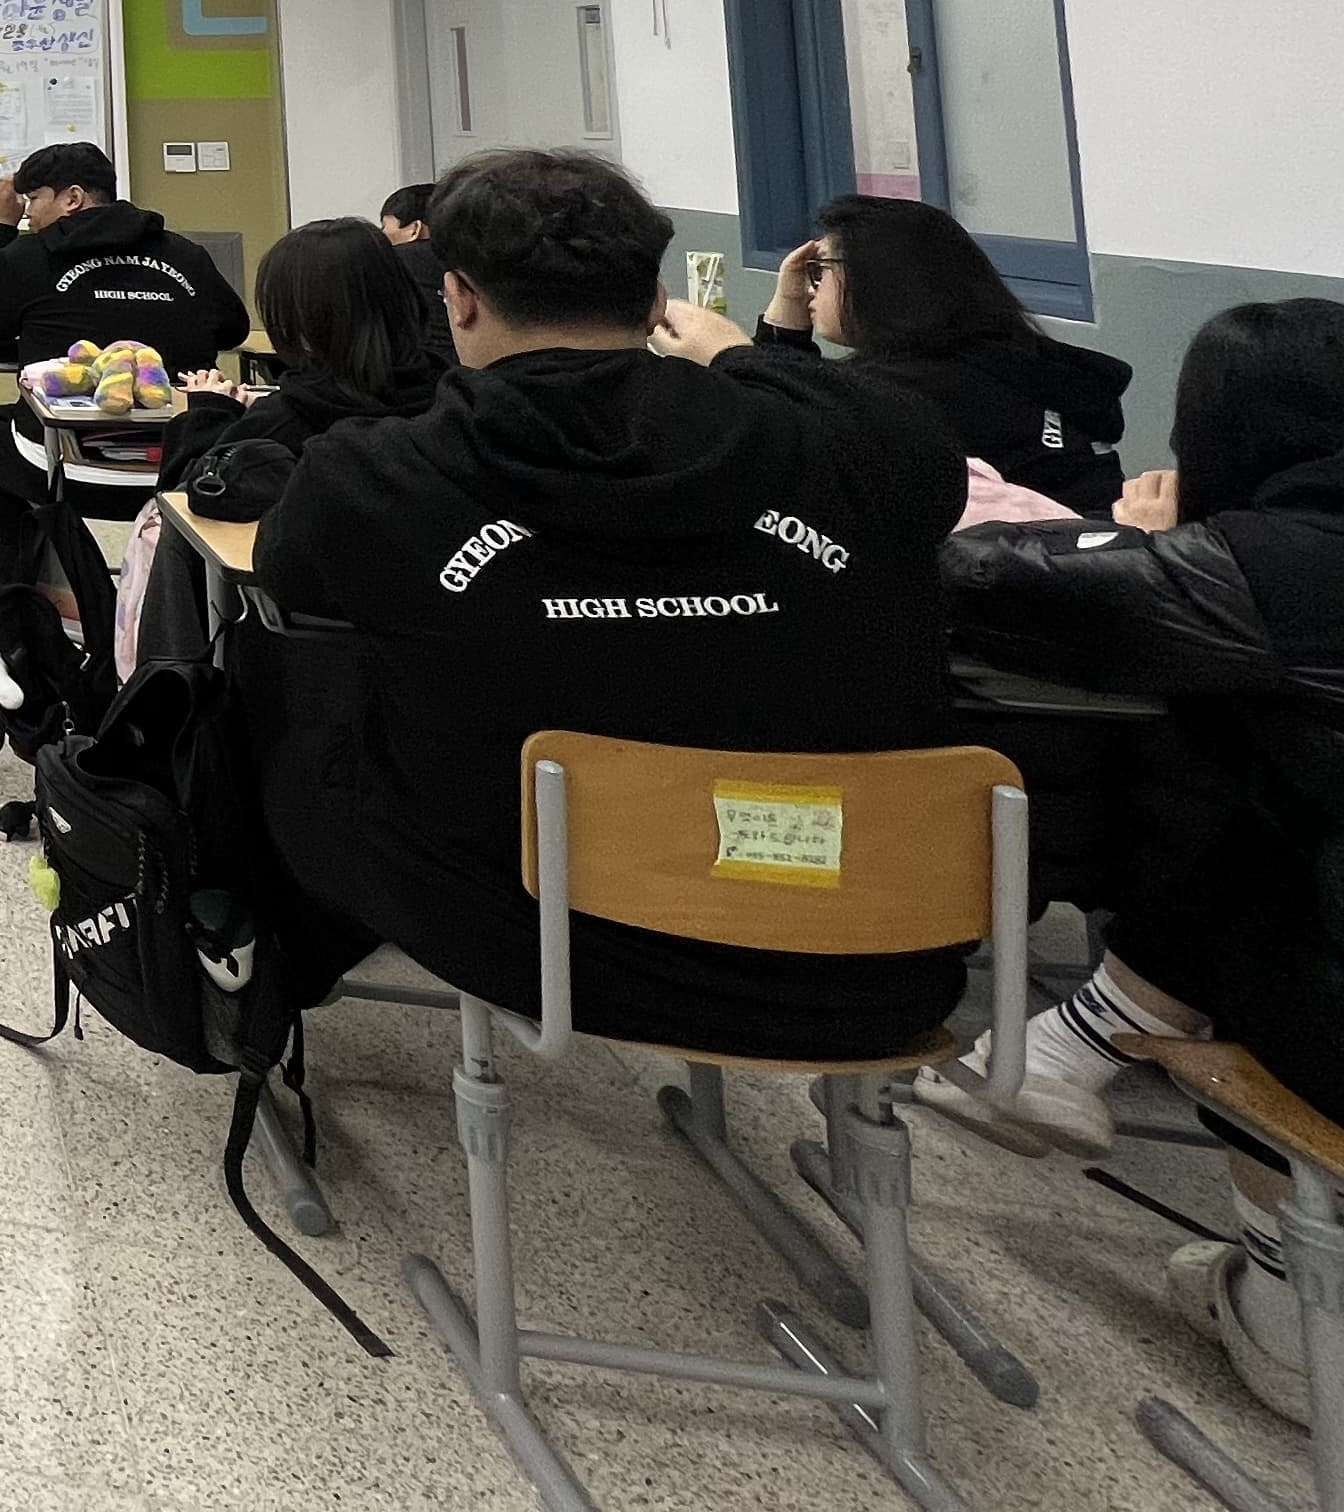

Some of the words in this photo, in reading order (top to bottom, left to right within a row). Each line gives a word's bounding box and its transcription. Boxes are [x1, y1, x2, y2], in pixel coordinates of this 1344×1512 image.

[55, 257, 102, 292] GYEONG
[104, 255, 141, 267] NAM
[141, 256, 196, 297] JAYEONG
[93, 289, 127, 300] HIGH
[127, 289, 175, 302] SCHOOL
[541, 596, 633, 620] HIGH
[635, 591, 780, 620] SCHOOL
